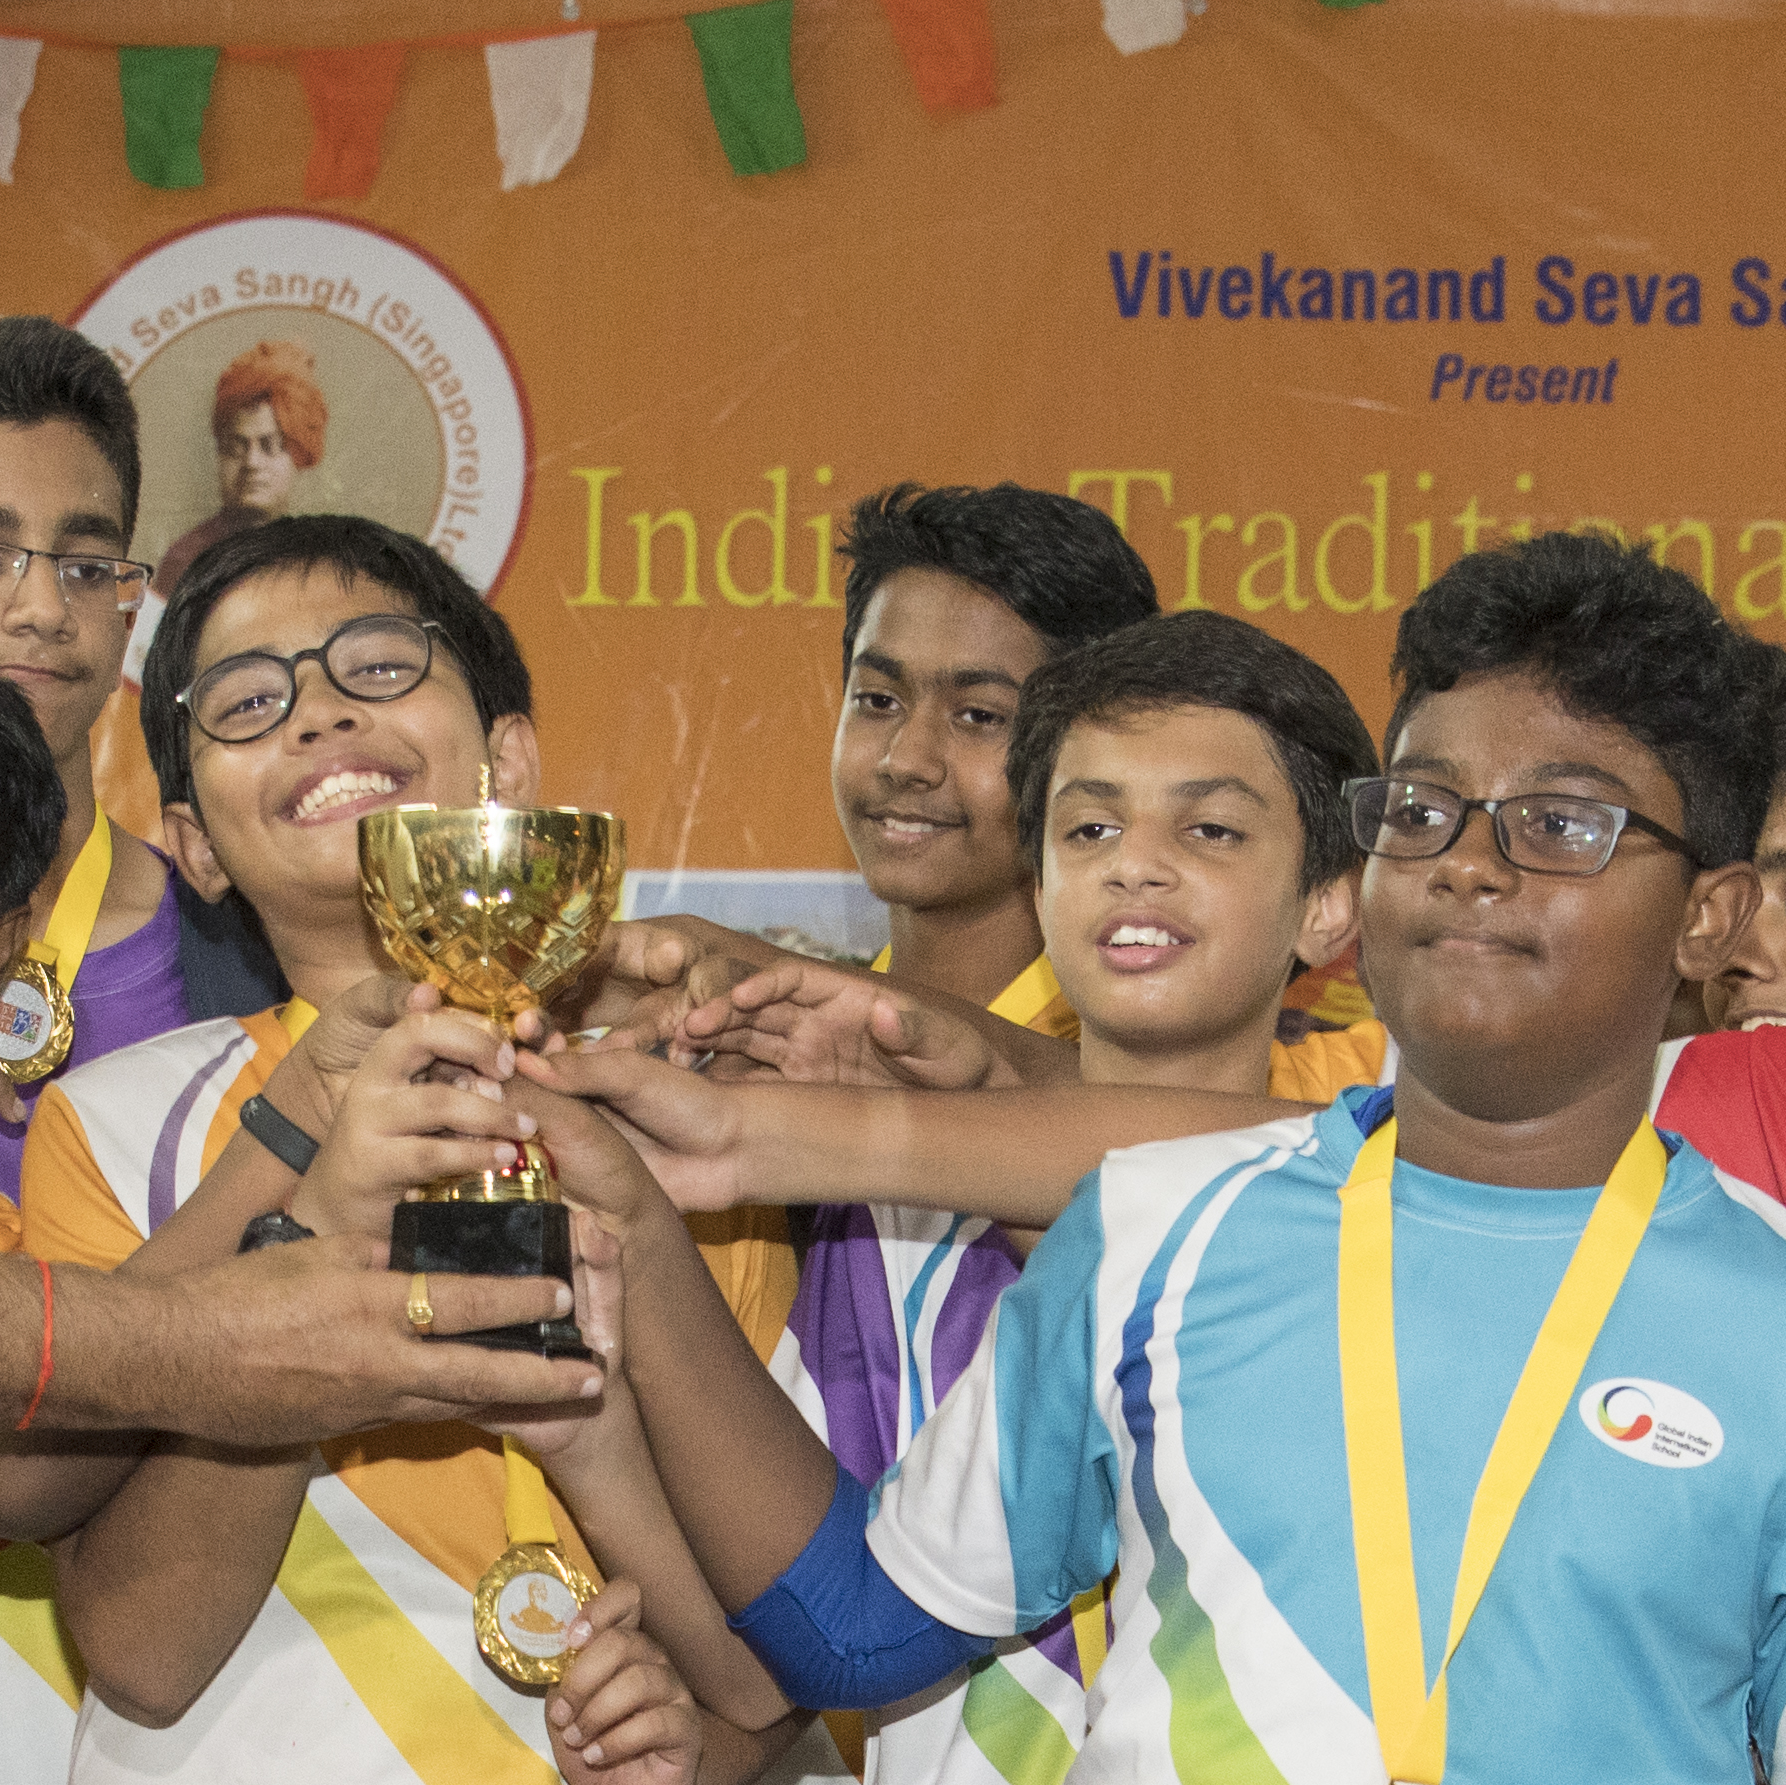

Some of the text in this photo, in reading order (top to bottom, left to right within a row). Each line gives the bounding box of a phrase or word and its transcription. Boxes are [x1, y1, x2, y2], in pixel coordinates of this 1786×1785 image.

[1108, 249, 1505, 323] Vivekanand
[1535, 254, 1702, 326] Seva
[130, 284, 222, 348] Seva
[234, 266, 361, 312] Sangh
[1429, 353, 1620, 403] Present
[1652, 1442, 1681, 1457] School
[1655, 1432, 1706, 1456] International
[1657, 1422, 1712, 1448] Global Indian
